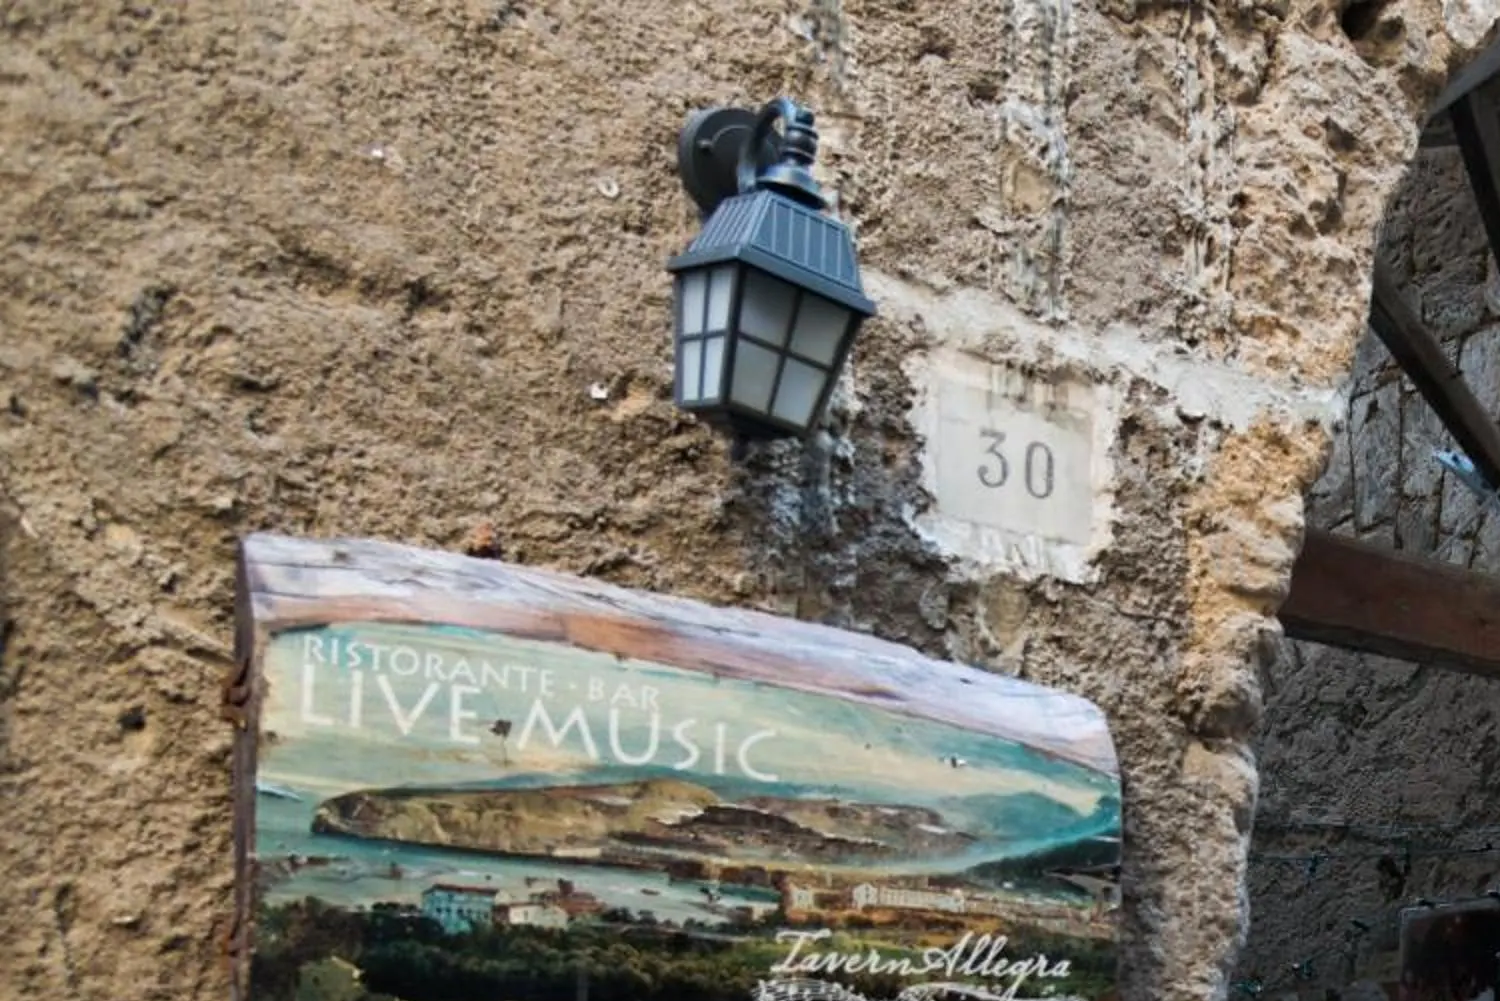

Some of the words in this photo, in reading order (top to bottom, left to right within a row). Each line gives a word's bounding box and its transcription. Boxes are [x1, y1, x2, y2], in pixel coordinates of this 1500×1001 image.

[976, 428, 1055, 500] 30
[303, 634, 555, 697] RISTORANTE
[588, 675, 661, 712] BAR
[302, 664, 483, 743] LIVE
[516, 698, 780, 783] MUSIC
